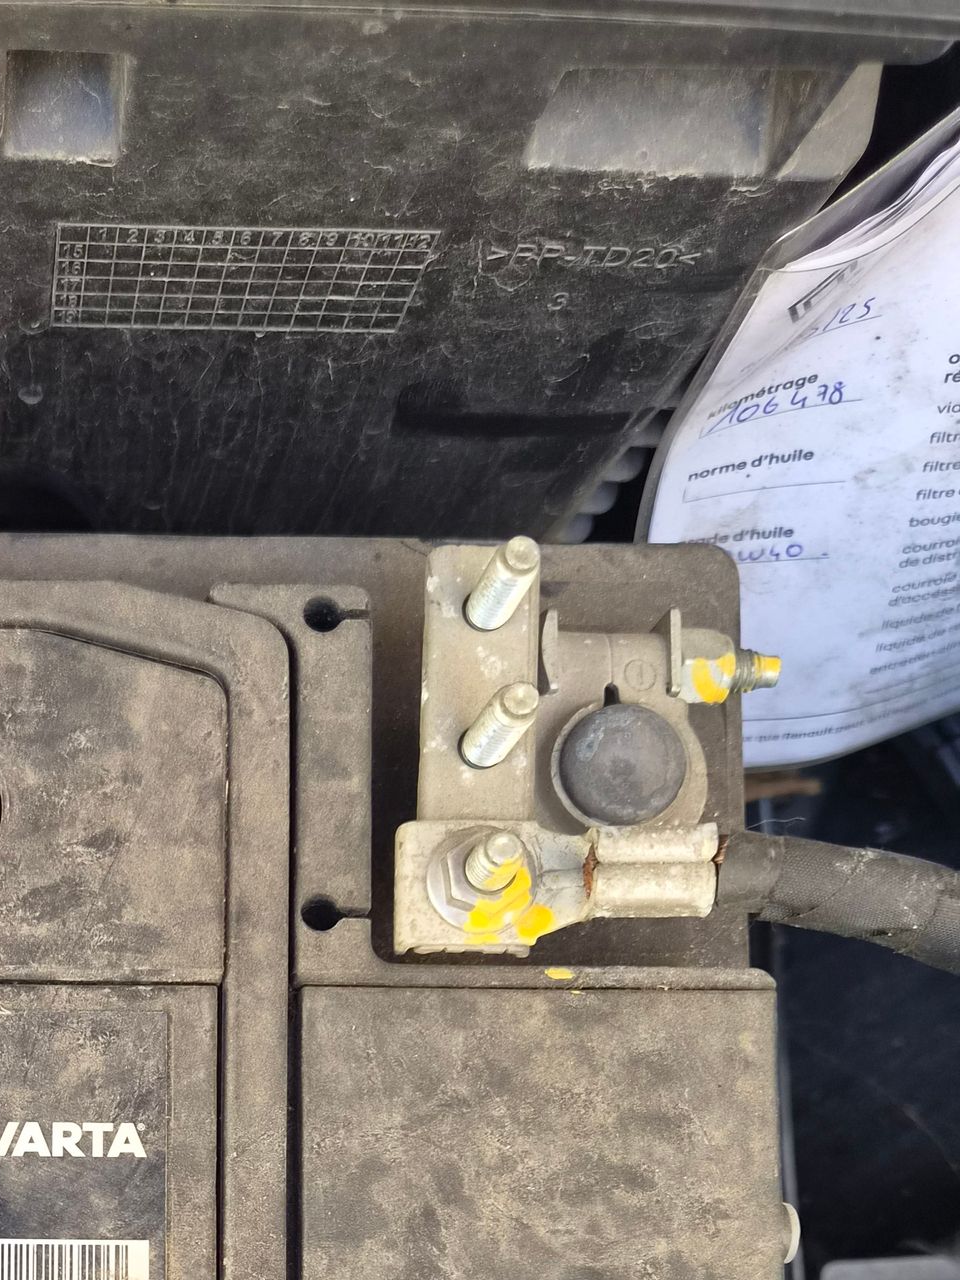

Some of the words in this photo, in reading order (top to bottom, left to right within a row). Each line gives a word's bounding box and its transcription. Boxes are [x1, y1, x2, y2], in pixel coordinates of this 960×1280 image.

[98, 227, 108, 242] 1
[126, 228, 140, 244] 2
[154, 229, 167, 244] 3
[183, 229, 196, 245] 4
[240, 231, 252, 246] 6
[271, 231, 284, 246] 7
[325, 232, 339, 247] 9
[62, 244, 84, 260] 15
[61, 260, 82, 277] 16
[60, 277, 81, 293] 17
[546, 291, 570, 312] 3
[707, 373, 819, 420] kilométrage
[688, 461, 747, 482] norme
[751, 449, 814, 468] d'huile
[916, 489, 955, 501] filtre
[679, 533, 730, 545] rade
[732, 527, 795, 542] d'huile
[728, 543, 804, 563] W40
[899, 558, 919, 569] de
